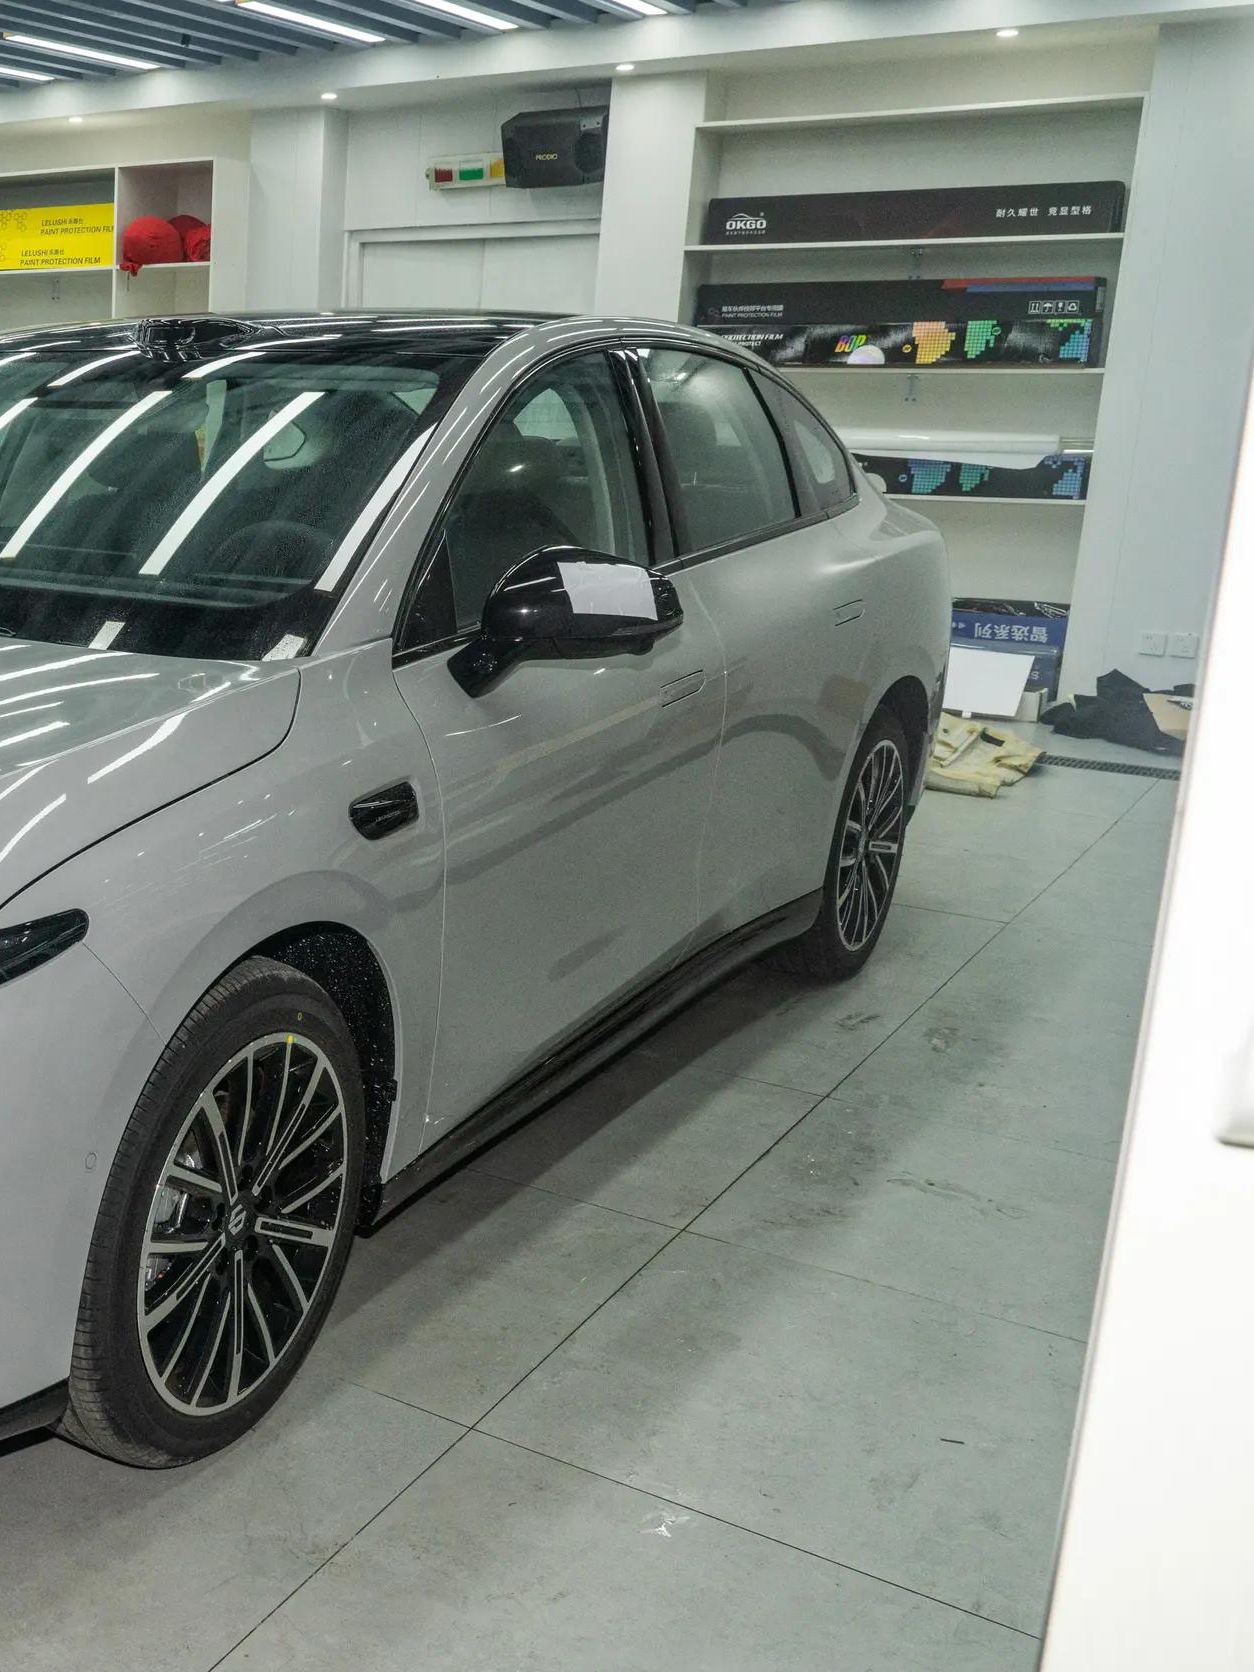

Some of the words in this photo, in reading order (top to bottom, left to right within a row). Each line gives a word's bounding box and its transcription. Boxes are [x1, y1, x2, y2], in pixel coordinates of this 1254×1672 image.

[725, 219, 767, 230] OKGO
[60, 226, 101, 234] PROTECTION
[102, 225, 114, 233] FIL
[21, 249, 48, 257] LELUSHI
[41, 257, 84, 265] PROTECTION
[84, 256, 101, 264] FILM
[974, 622, 1049, 643] 智选系列
